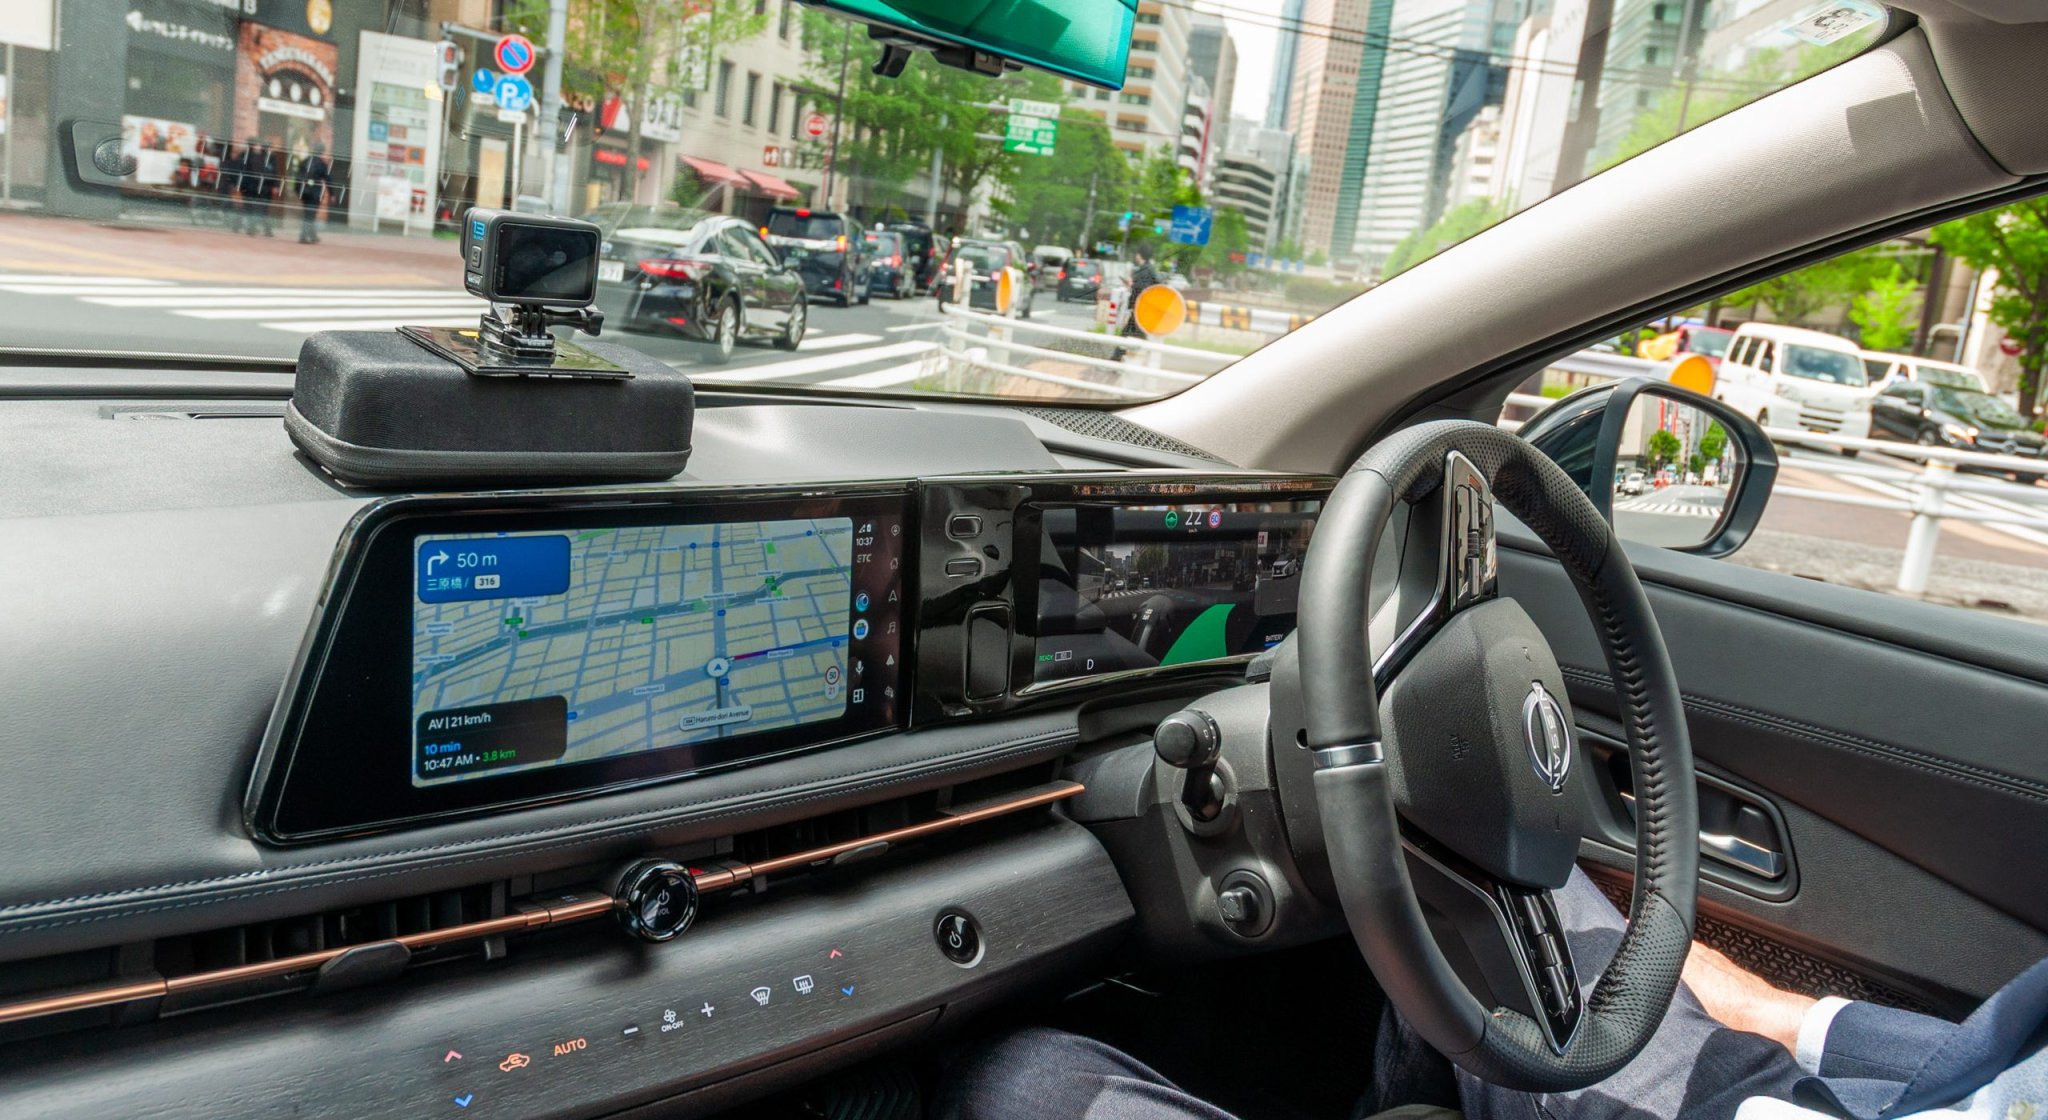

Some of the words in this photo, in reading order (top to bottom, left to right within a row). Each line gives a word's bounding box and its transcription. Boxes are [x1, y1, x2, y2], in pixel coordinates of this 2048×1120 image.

[501, 82, 518, 106] P
[1185, 509, 1202, 526] 22
[856, 537, 874, 546] 10:37
[457, 552, 478, 568] 50
[482, 554, 497, 567] m
[856, 553, 872, 563] ETC
[427, 576, 462, 591] 三原橋
[479, 577, 496, 587] 316
[1265, 634, 1284, 642] BATTERY
[1086, 658, 1094, 670] D
[829, 670, 837, 680] 50
[828, 686, 835, 696] 21
[428, 717, 444, 731] AV
[451, 715, 463, 727] 21
[464, 712, 491, 726] km/h
[696, 711, 728, 723] Harumi-dori
[729, 710, 750, 719] Avenue
[1532, 682, 1562, 791] NISSAN
[424, 744, 438, 755] 10
[440, 741, 462, 754] min
[424, 756, 452, 771] 10:47
[455, 753, 473, 766] AM
[482, 750, 498, 762] 3.8
[499, 748, 516, 760] km
[658, 907, 669, 916] VOL
[554, 1038, 587, 1056] AUTO
